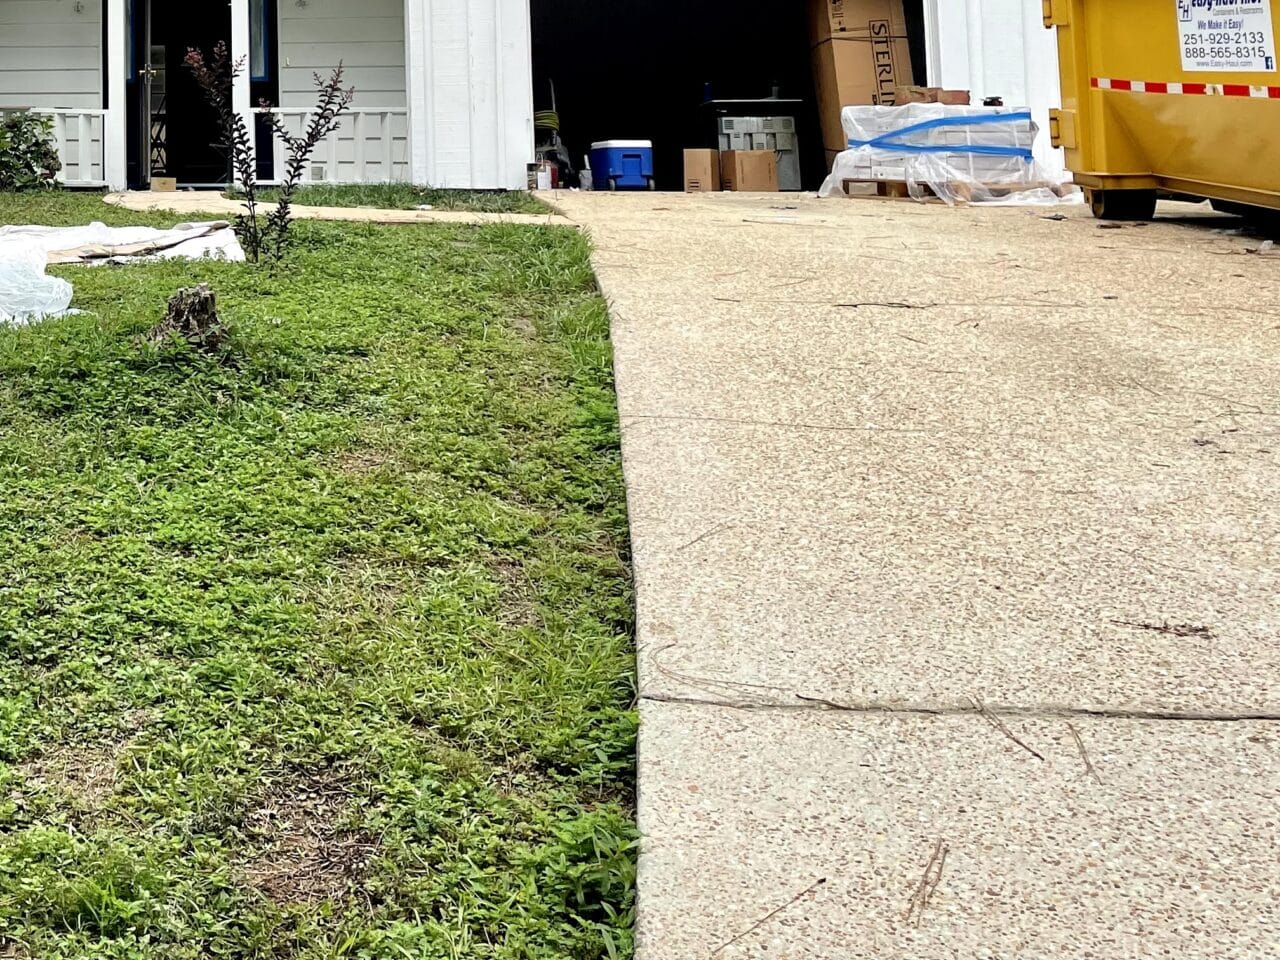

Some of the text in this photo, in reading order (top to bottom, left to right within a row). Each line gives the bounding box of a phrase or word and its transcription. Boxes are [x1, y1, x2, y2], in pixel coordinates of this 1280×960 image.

[1198, 20, 1206, 30] We
[1207, 20, 1222, 30] Make
[1184, 32, 1264, 45] 251-929-2133
[1185, 46, 1266, 58] 888-565-8315
